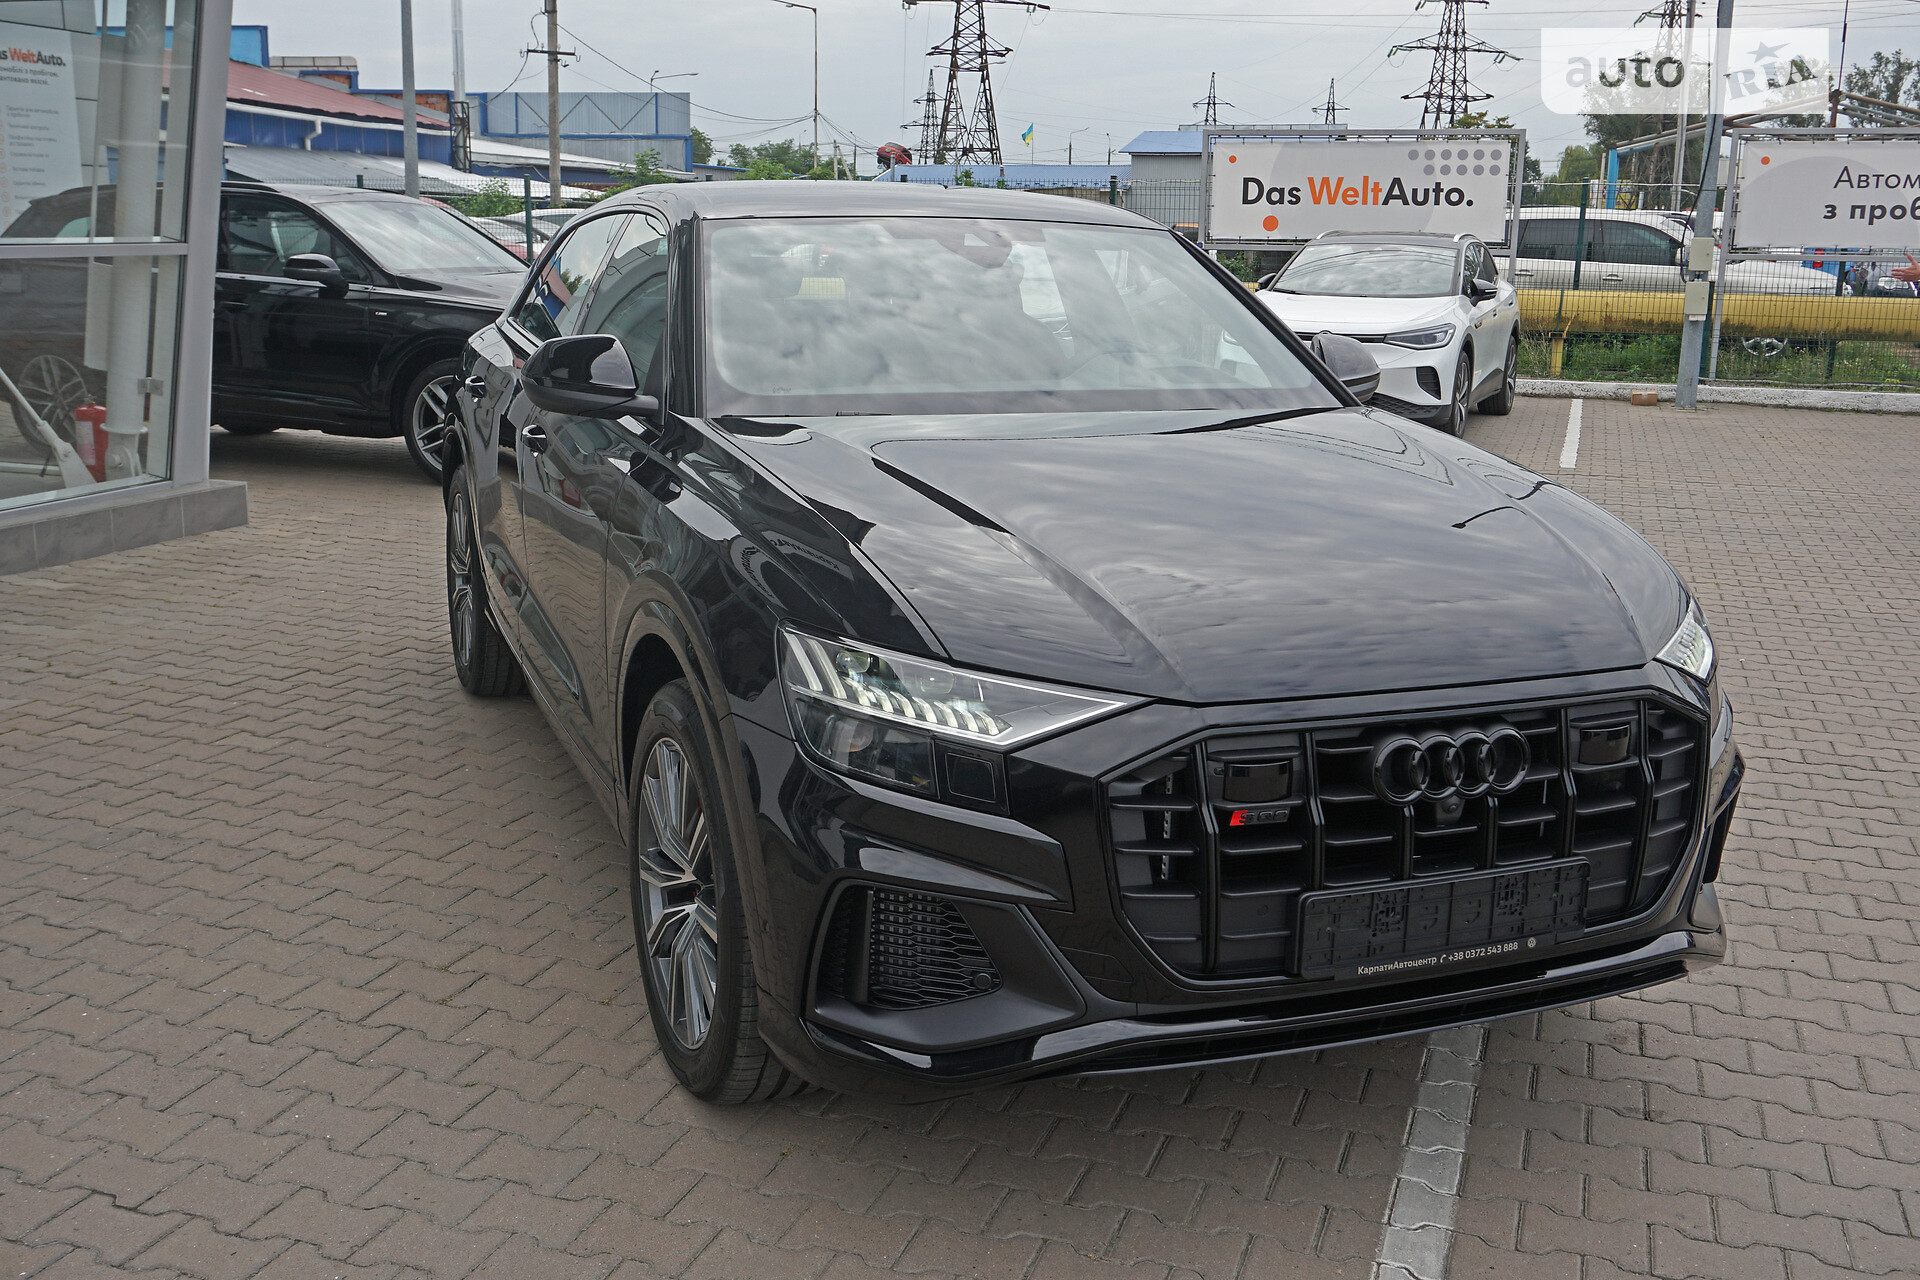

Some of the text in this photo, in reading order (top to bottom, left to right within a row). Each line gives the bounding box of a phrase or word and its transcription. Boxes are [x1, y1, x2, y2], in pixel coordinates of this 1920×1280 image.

[8, 47, 66, 67] WeltAuto.
[1241, 175, 1474, 207] Das WeltAuto.
[1833, 165, 1920, 189] Автом
[1823, 196, 1920, 226] з проб
[1357, 942, 1519, 976] КарпатиАвтоцентр +38 0372 543 888
